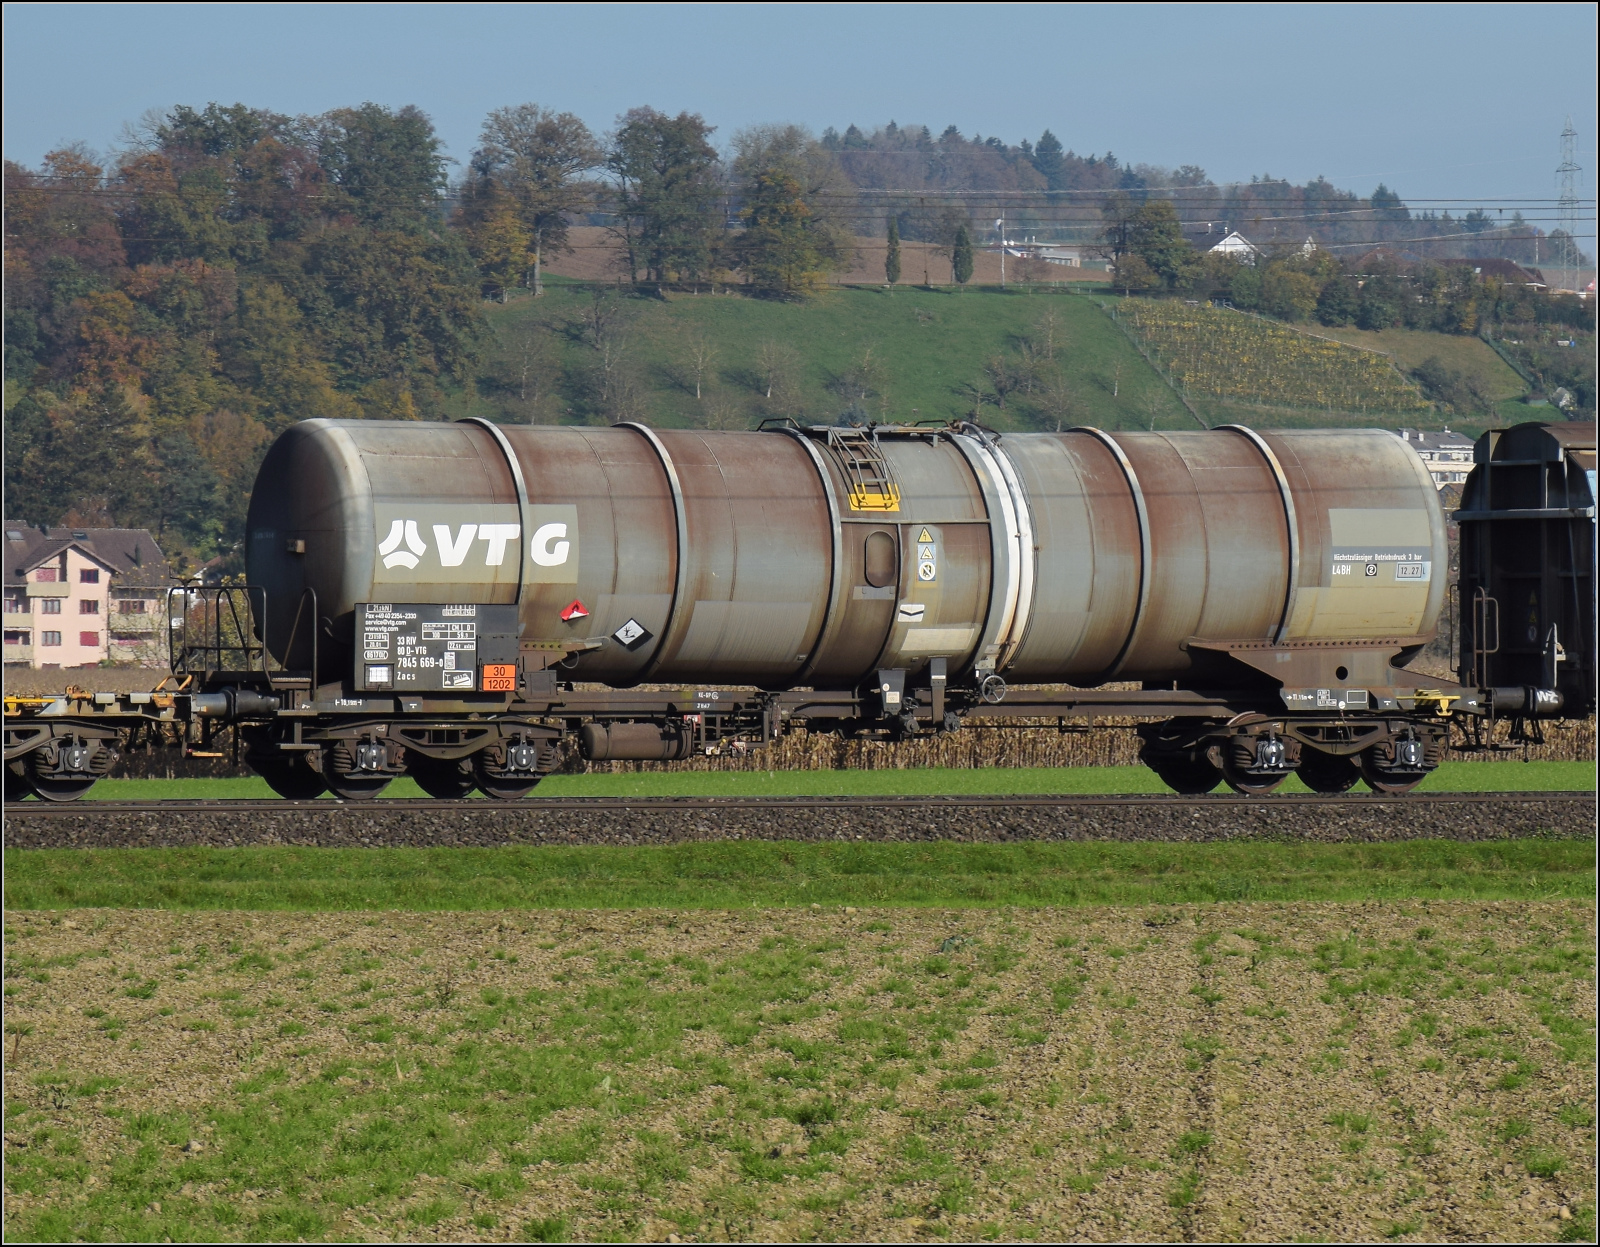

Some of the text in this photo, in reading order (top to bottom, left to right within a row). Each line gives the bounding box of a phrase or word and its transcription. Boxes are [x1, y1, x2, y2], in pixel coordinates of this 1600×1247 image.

[432, 523, 570, 567] VTG
[1414, 553, 1423, 561] bar
[1332, 564, 1351, 575] L4BH
[1400, 566, 1420, 575] 12.27
[365, 619, 407, 627] service@vtg.com
[397, 636, 417, 646] 33 RIV
[397, 646, 405, 655] 80
[397, 657, 417, 668] 7845
[420, 657, 444, 668] 669-0
[397, 671, 416, 680] Zacs
[493, 666, 506, 676] 30
[488, 679, 511, 689] 1202
